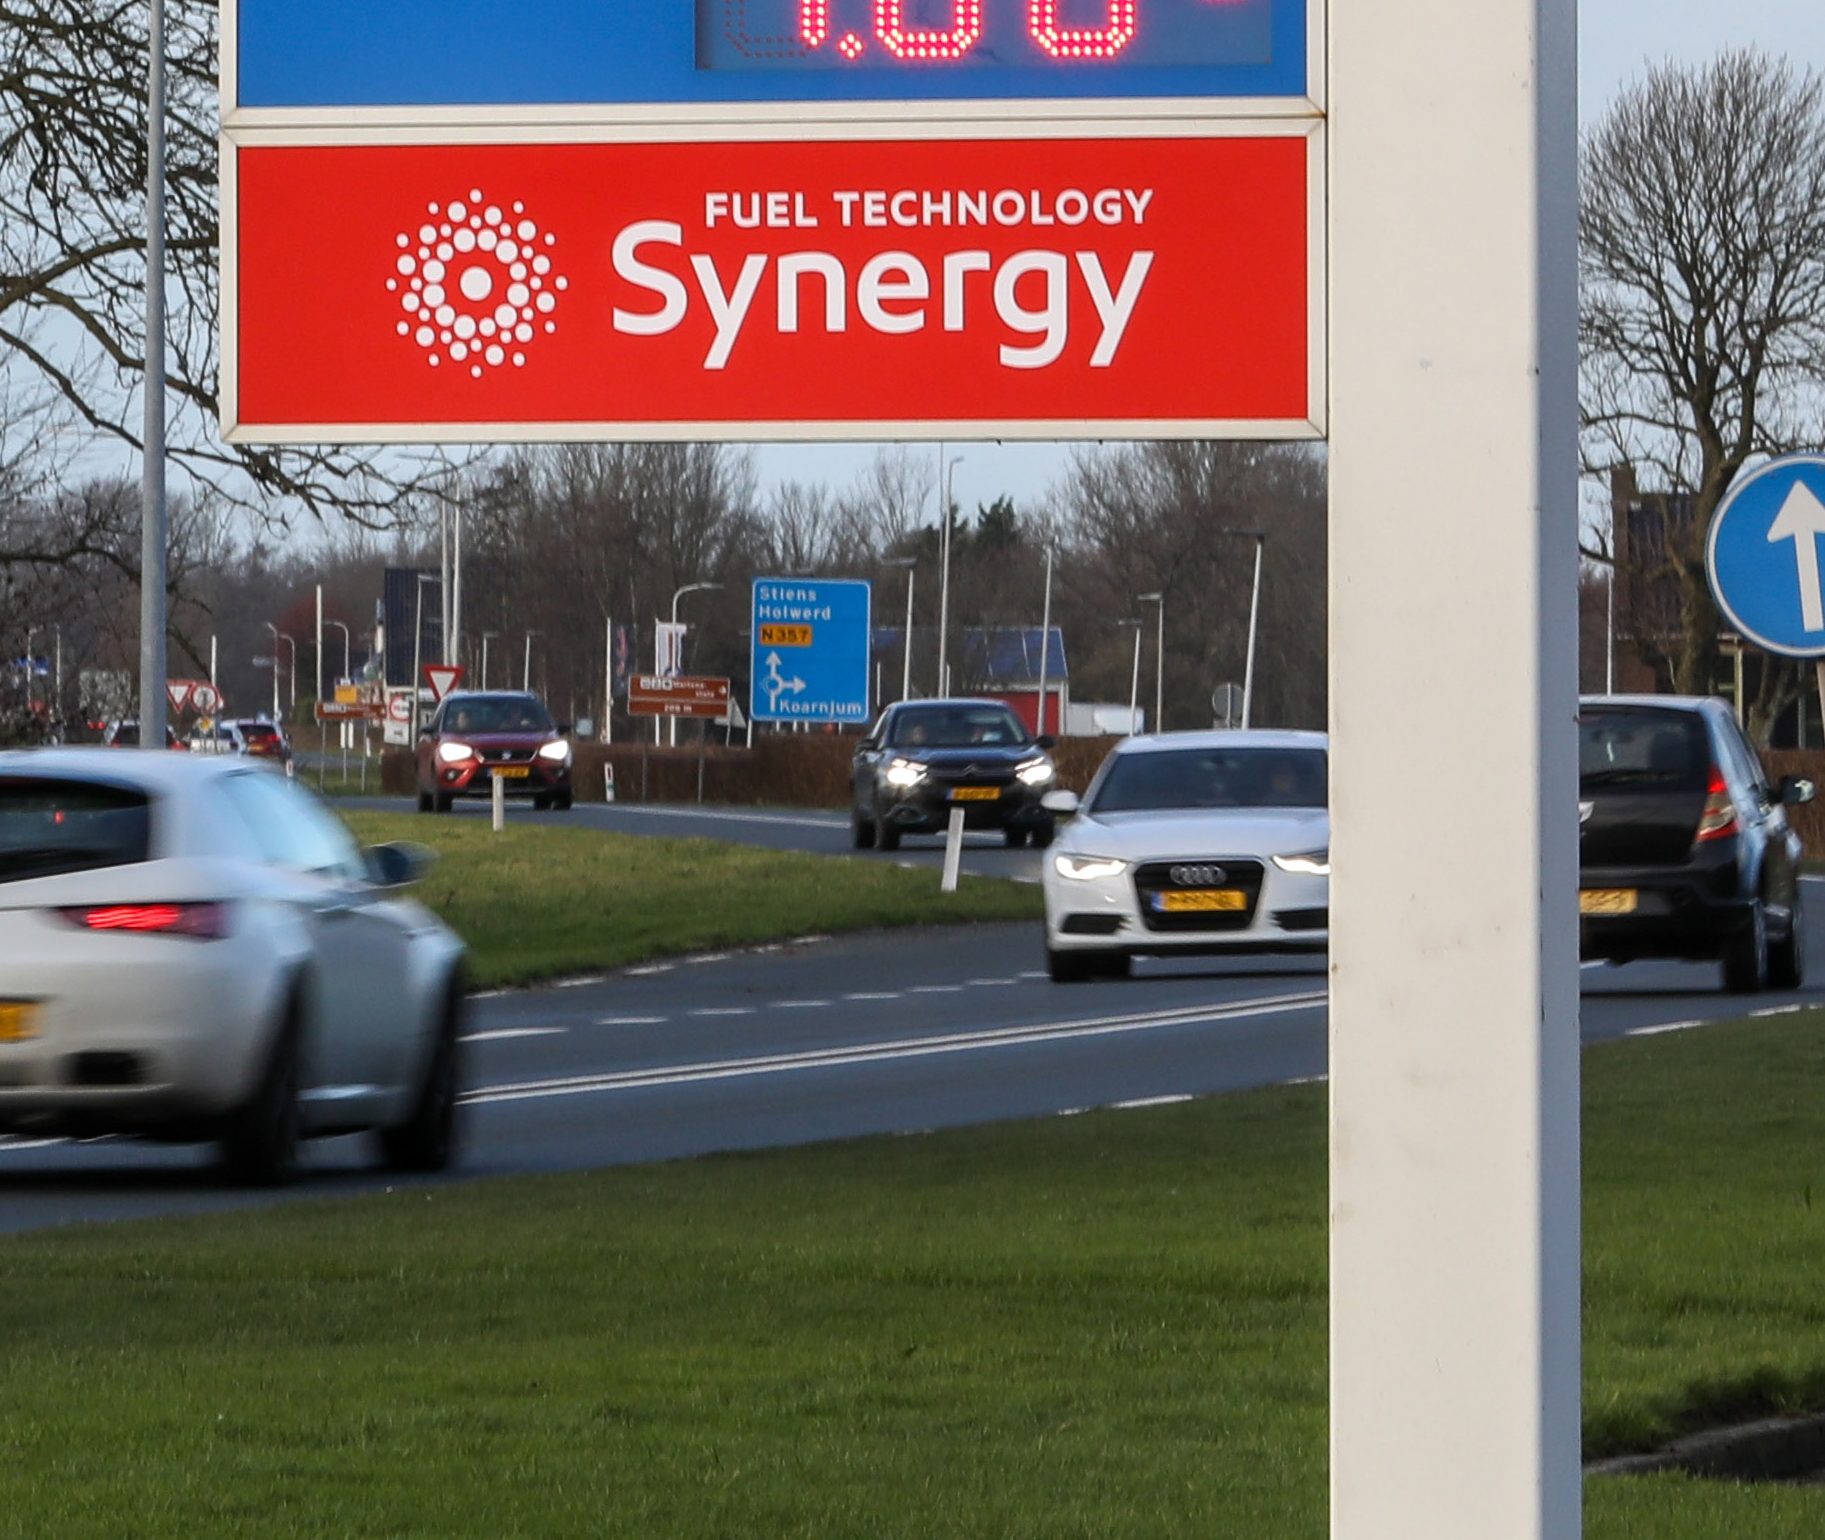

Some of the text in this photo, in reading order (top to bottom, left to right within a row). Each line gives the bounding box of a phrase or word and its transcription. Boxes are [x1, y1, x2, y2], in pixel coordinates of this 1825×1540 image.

[704, 188, 1154, 229] FUEL TECHNOLOGY
[611, 219, 1155, 371] Synergy
[759, 585, 817, 602] Stiens
[759, 604, 831, 621] Holwerd
[779, 699, 862, 719] Koarnjum
